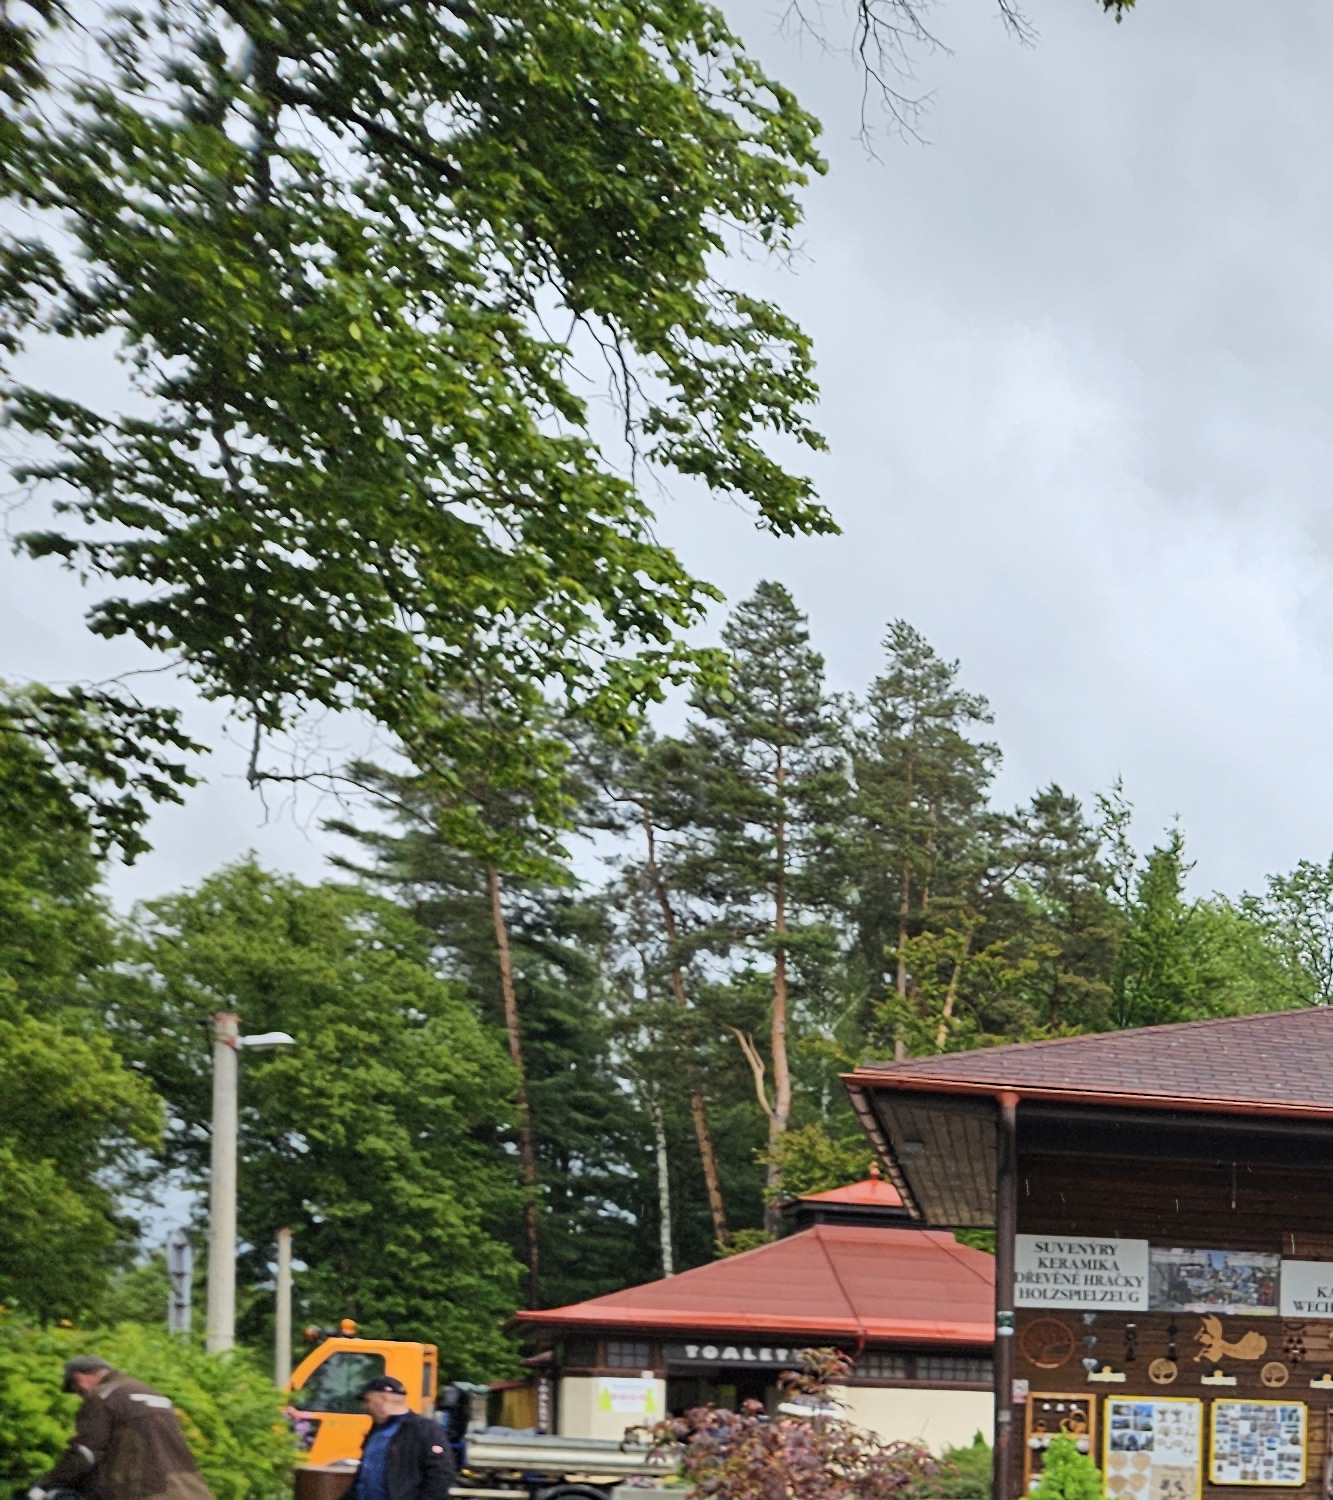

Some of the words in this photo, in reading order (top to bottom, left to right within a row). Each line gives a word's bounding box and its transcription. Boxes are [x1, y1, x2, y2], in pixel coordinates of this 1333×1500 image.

[1034, 1240, 1118, 1256] SUVENÝRY
[1038, 1257, 1120, 1271] KERAMIKA
[1019, 1287, 1140, 1303] HOLZSPIELZEUG
